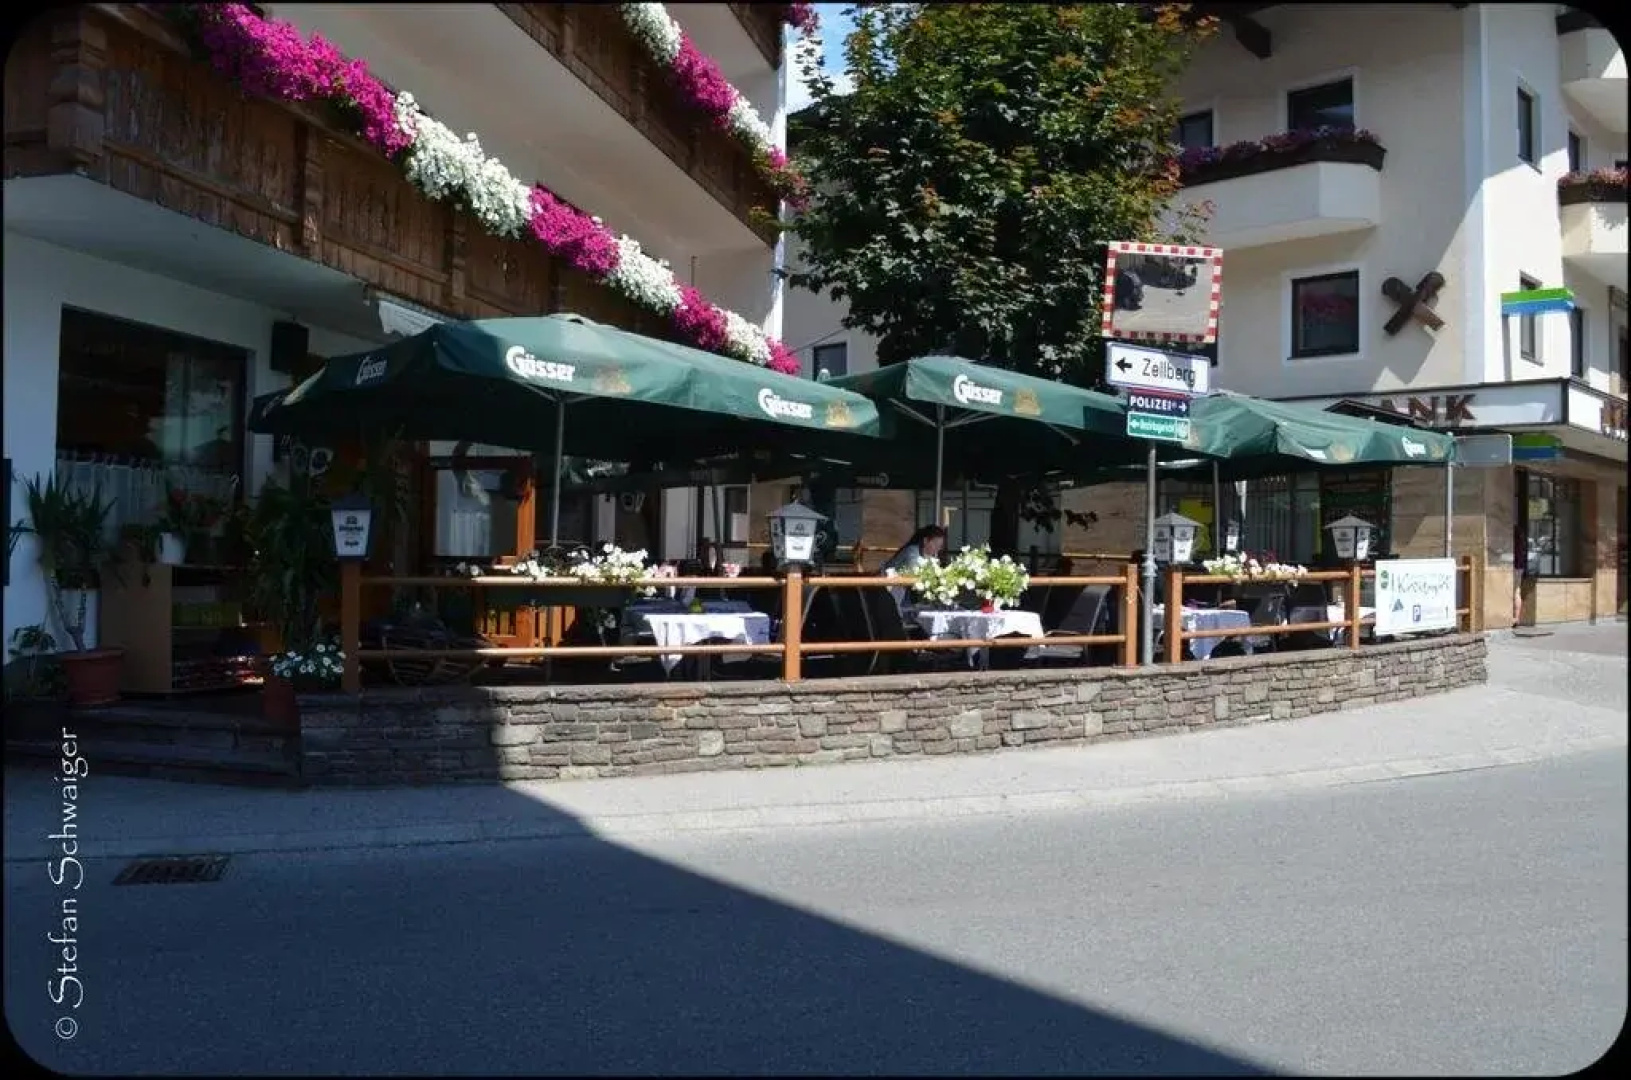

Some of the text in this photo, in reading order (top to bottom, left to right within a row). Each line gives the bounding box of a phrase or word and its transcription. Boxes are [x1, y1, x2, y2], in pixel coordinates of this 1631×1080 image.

[506, 345, 575, 382] Gösser
[1142, 358, 1196, 388] Zellberg
[758, 388, 812, 419] Gösser
[954, 374, 1003, 404] Gösser
[1130, 395, 1172, 411] POLIZEI
